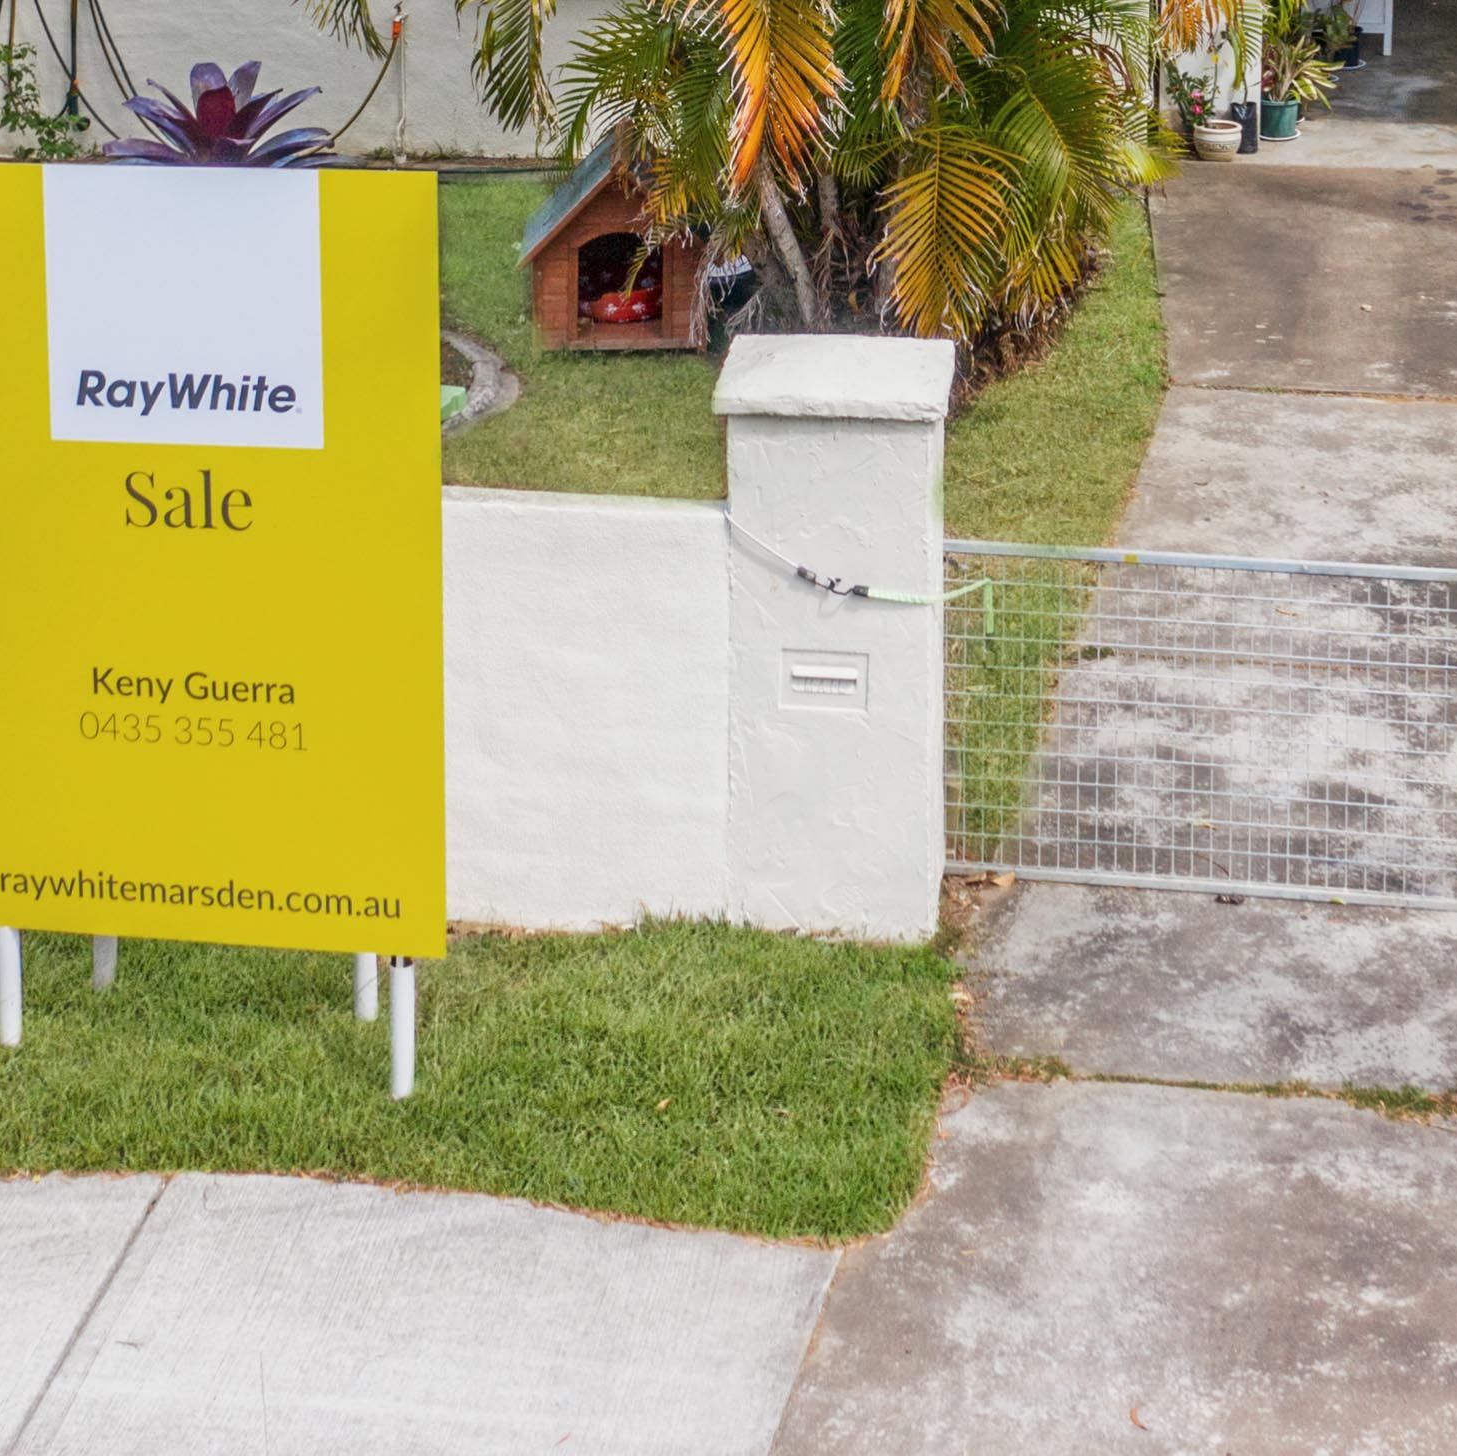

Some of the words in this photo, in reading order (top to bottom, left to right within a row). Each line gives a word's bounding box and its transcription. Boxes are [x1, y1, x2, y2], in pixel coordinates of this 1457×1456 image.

[124, 468, 254, 532] Sale
[92, 666, 174, 705] Keny
[184, 671, 296, 705] Guerra
[79, 710, 162, 744] 0435
[174, 715, 235, 748] 355
[246, 720, 308, 752] 481
[0, 869, 402, 919] raywhitemarsden.com.au
